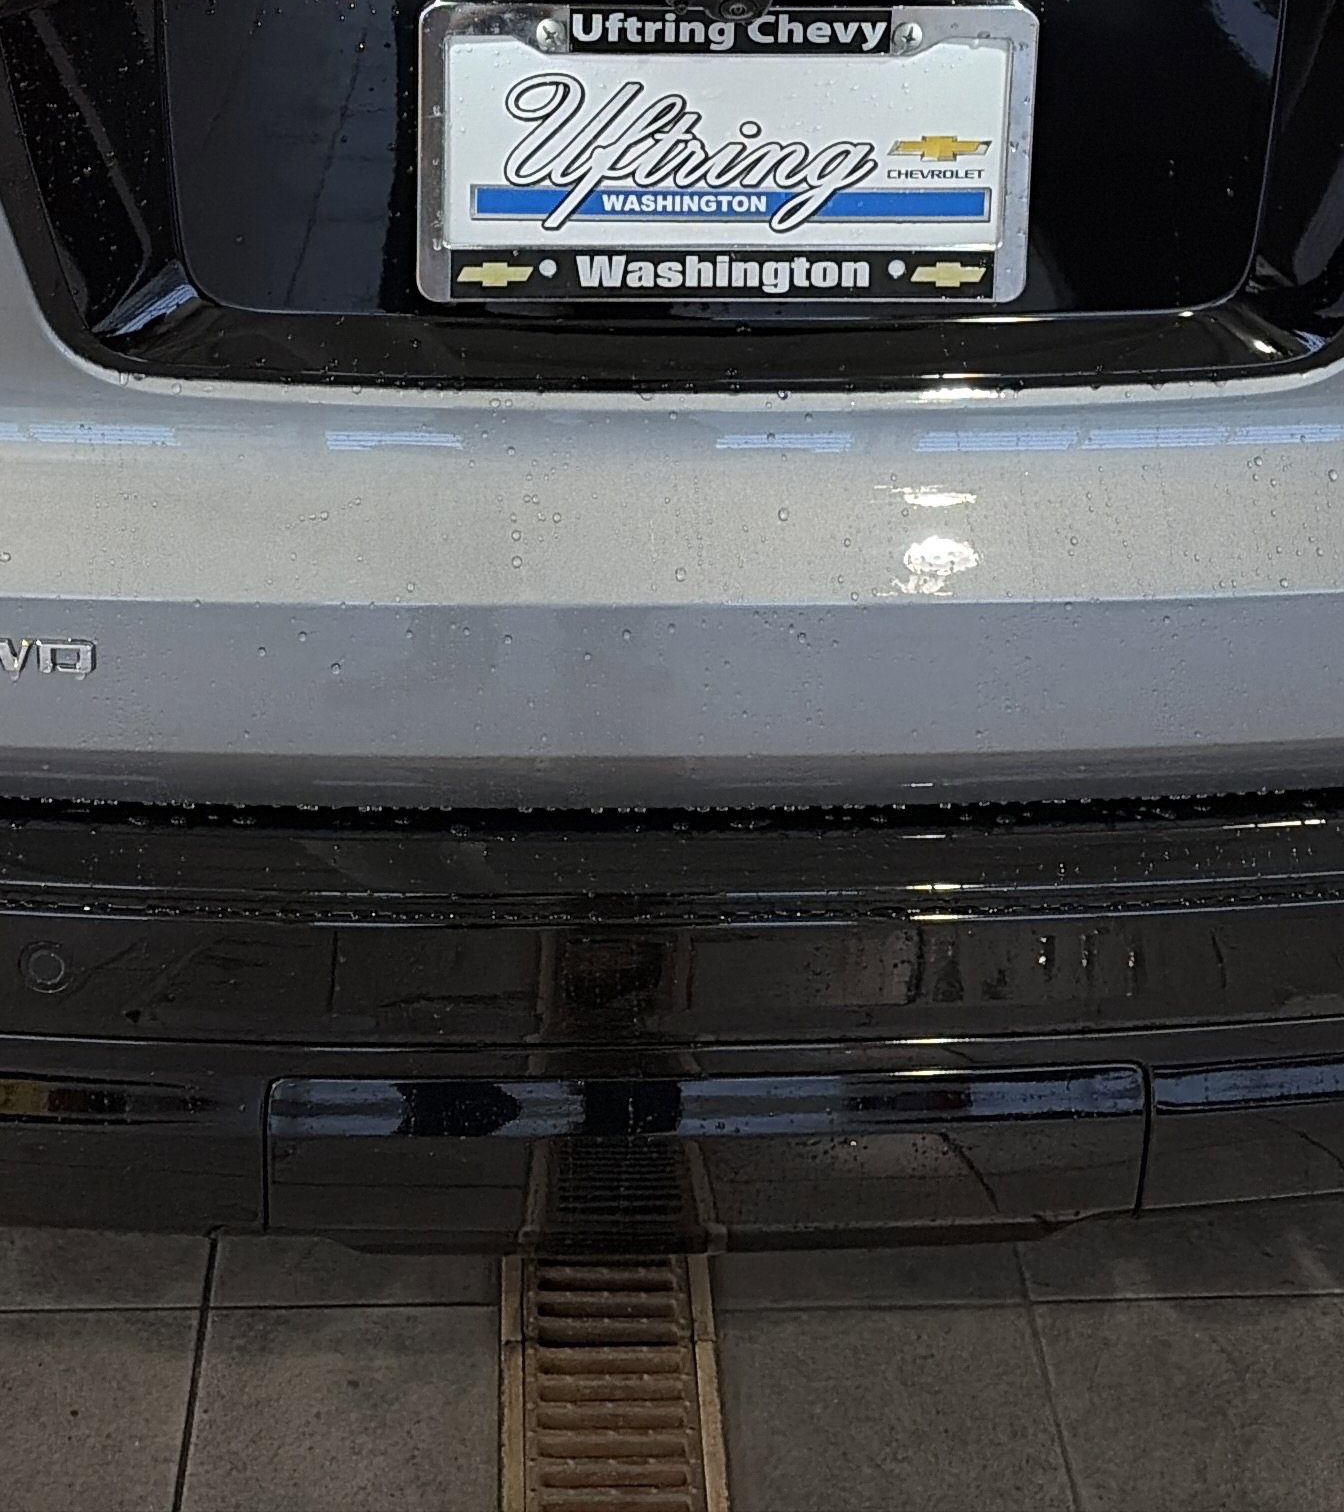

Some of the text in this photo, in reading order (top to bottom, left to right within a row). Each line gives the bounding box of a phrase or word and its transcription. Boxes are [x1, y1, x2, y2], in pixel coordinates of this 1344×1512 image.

[571, 11, 888, 53] Uftring Chevy
[504, 72, 879, 233] Uftring
[886, 169, 986, 180] CHEVROLET
[601, 194, 768, 214] WASHINGTON
[576, 255, 871, 294] Washington
